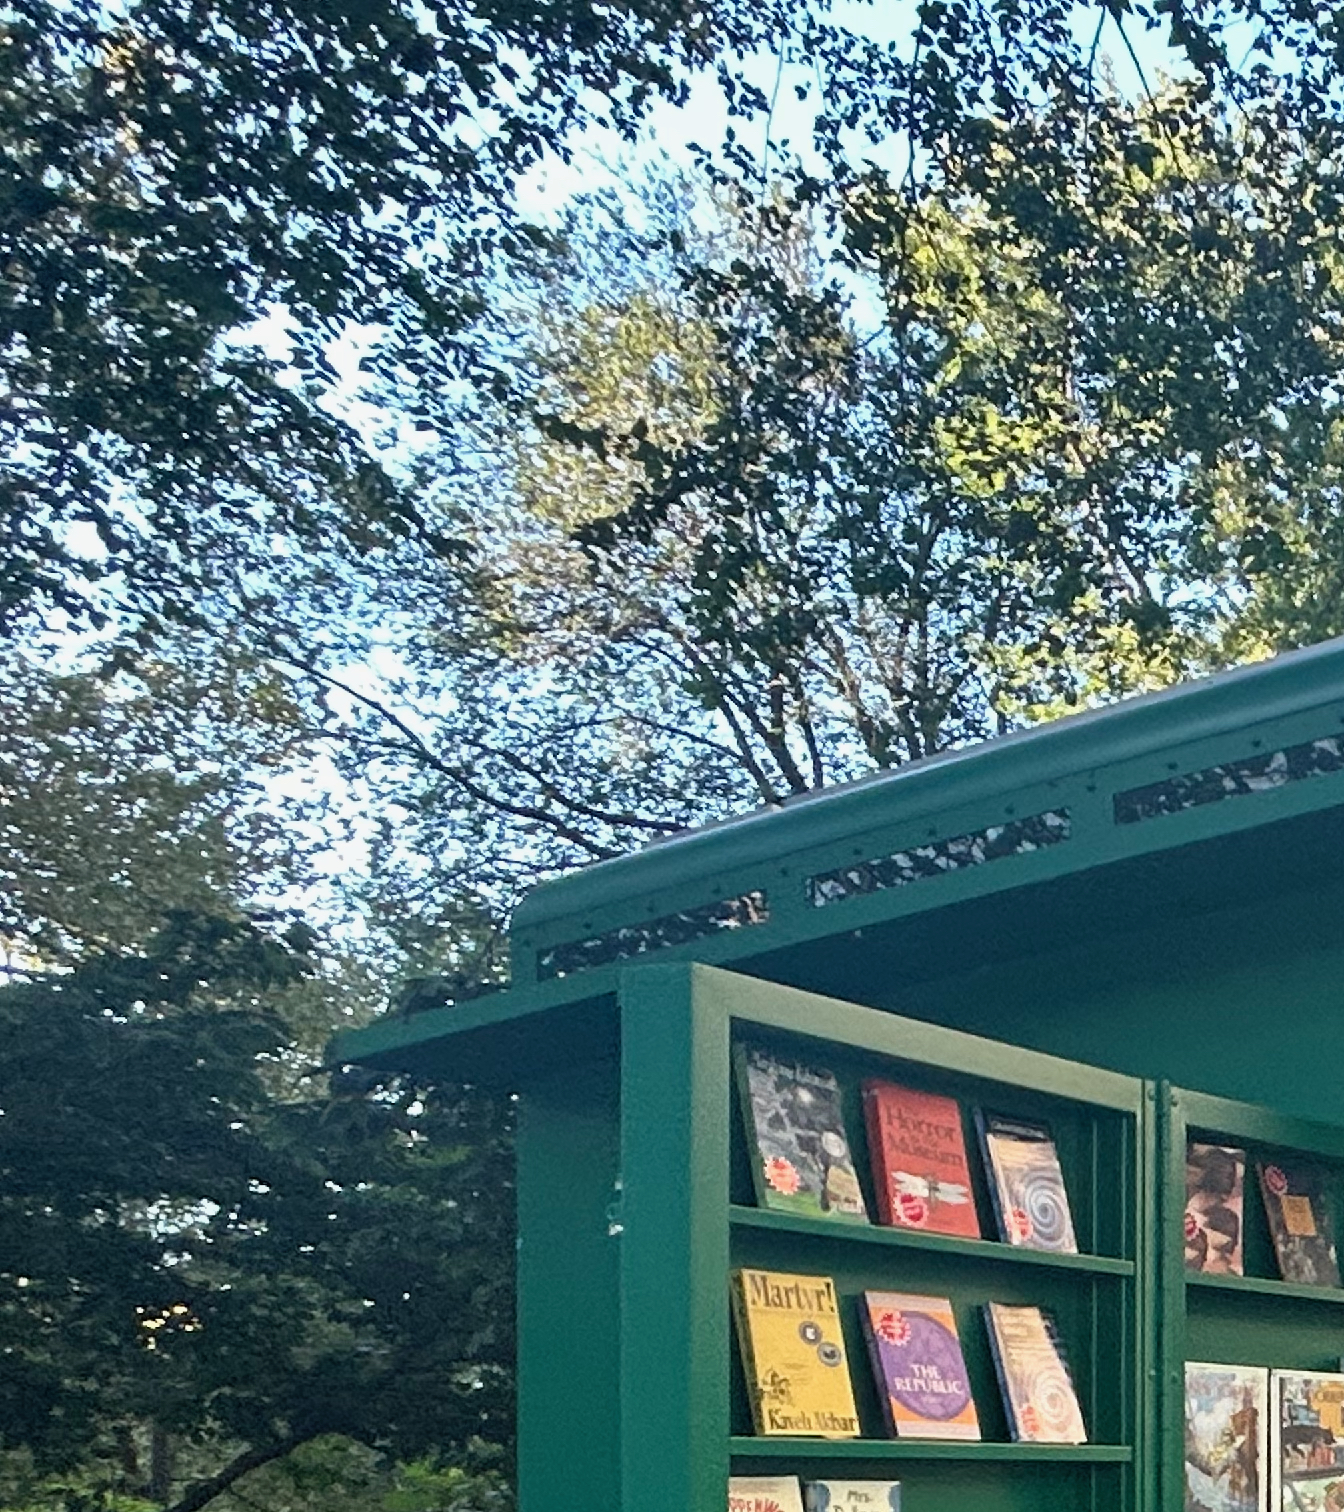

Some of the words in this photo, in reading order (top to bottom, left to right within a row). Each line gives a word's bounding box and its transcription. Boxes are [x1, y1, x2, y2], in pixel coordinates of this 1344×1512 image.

[885, 1104, 956, 1142] Horror
[749, 1273, 835, 1314] Martyr!
[909, 1363, 941, 1380] THE
[893, 1377, 964, 1395] REPUBLIC
